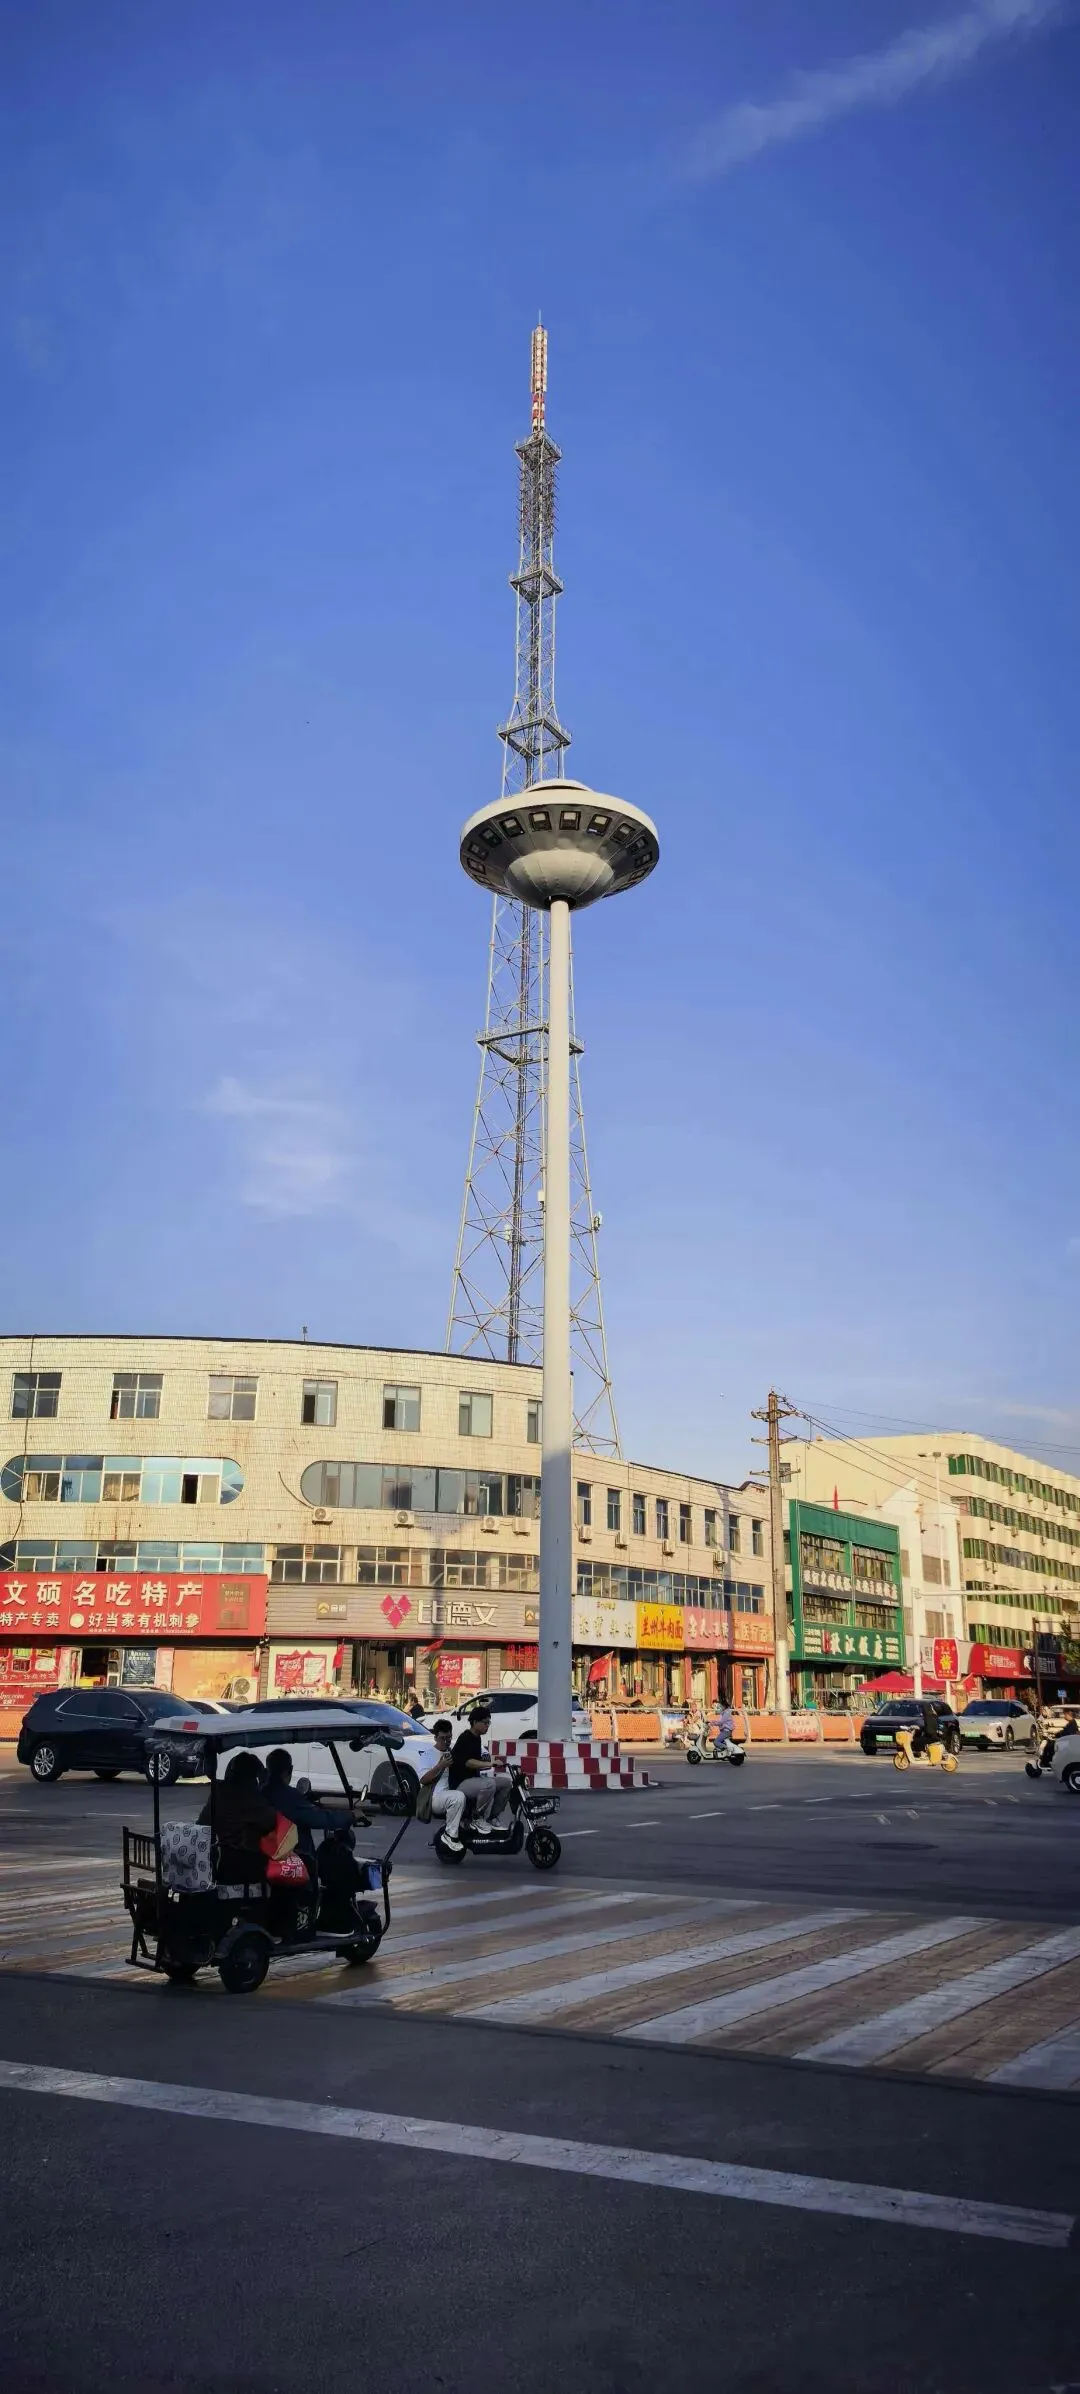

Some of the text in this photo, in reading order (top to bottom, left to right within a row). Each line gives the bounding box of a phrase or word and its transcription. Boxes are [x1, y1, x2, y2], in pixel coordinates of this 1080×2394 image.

[1, 1580, 203, 1608] 文硕名吃特产
[88, 1611, 200, 1629] 好当家有机刺参
[417, 1599, 499, 1627] 比德文
[641, 1616, 683, 1640] 兰州牛肉面
